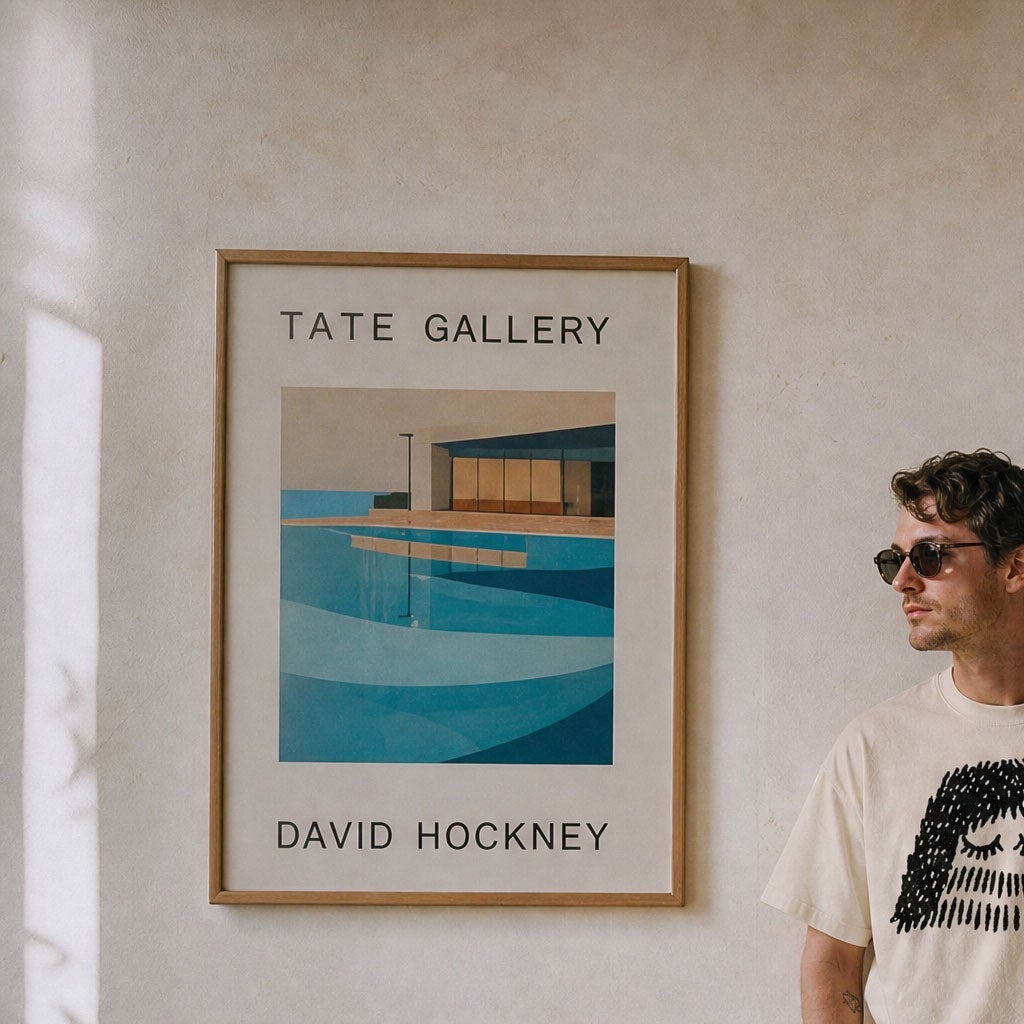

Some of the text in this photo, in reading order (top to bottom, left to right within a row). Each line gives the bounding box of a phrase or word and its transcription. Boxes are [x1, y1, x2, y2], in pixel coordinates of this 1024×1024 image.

[280, 311, 610, 345] TATE GALLERY
[277, 820, 609, 851] DAVID HOCKNEY
